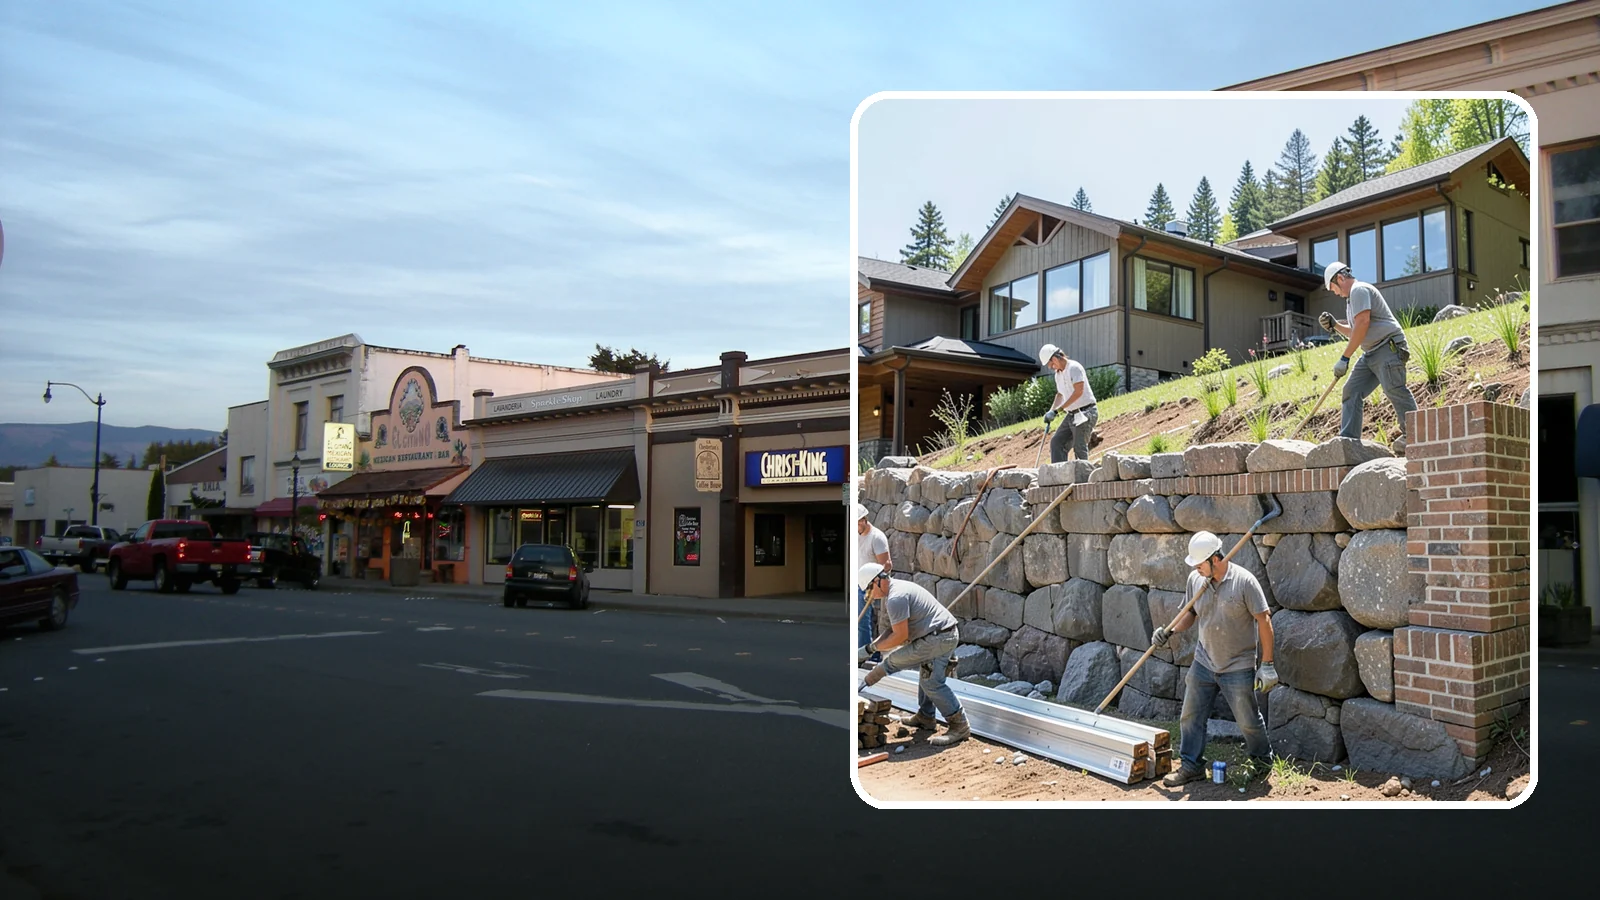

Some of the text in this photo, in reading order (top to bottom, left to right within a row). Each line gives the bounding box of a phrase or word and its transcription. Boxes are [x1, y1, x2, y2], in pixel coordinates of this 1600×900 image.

[530, 394, 582, 409] Sparkle Shop
[595, 389, 624, 400] LAUNDRY
[493, 402, 523, 412] LAVANDERIA
[373, 455, 396, 464] MEXICAN
[397, 451, 434, 462] RESTAURANT
[437, 450, 450, 459] BAR
[761, 450, 827, 478] CHRIST KING
